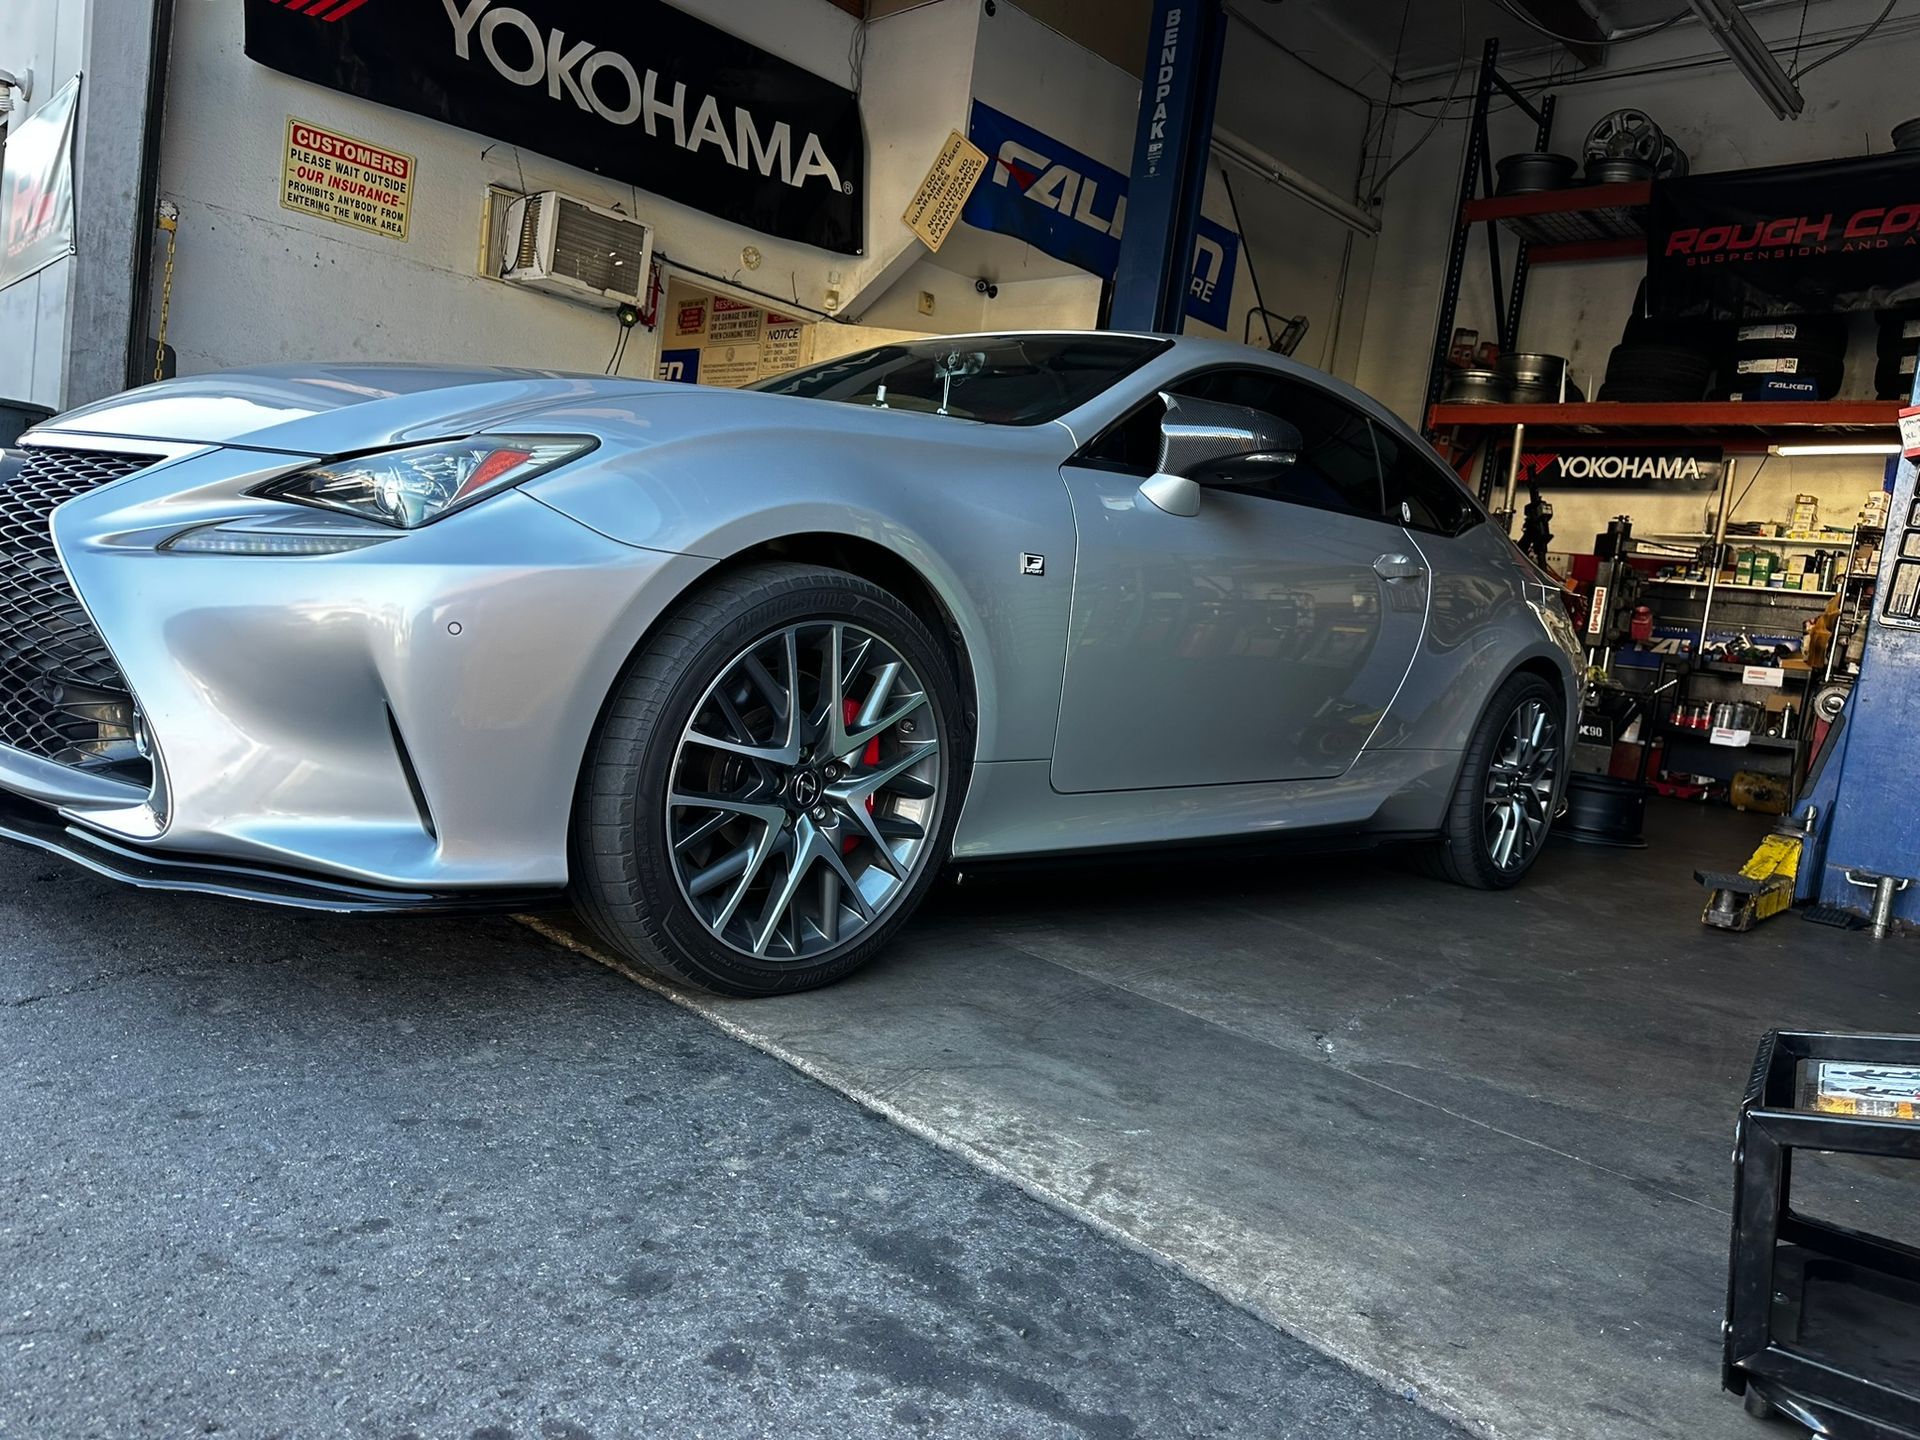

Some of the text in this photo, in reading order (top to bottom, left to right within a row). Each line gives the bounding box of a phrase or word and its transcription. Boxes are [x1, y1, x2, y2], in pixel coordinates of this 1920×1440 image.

[442, 0, 842, 194] YOKOHAMA
[1150, 8, 1181, 141] BENDPAK
[290, 148, 407, 193] PLEASE WAIT OUTSIDE
[296, 129, 406, 176] CUSTOMERS
[288, 179, 404, 222] PROHIBITS ANYBODY FROM
[297, 166, 399, 207] OUR INSURANCE
[911, 141, 961, 225] GUARANTEE USED
[915, 151, 948, 206] WE DO NOT
[927, 158, 969, 229] NOSOTROS NO
[930, 159, 976, 236] GARANTIZAMOS
[932, 174, 951, 201] TIRES
[287, 192, 402, 234] ENTERING THE WORK AREA
[932, 160, 982, 244] LLANTAS USADAS
[1665, 203, 1920, 257] ROUGH CO
[1687, 245, 1827, 267] SUSPENSION
[1842, 239, 1889, 252] AND
[738, 320, 758, 329] WHEELS
[767, 328, 799, 340] NOTICE
[1767, 381, 1813, 391] FALKEN
[1558, 455, 1700, 479] YOKOHAMA
